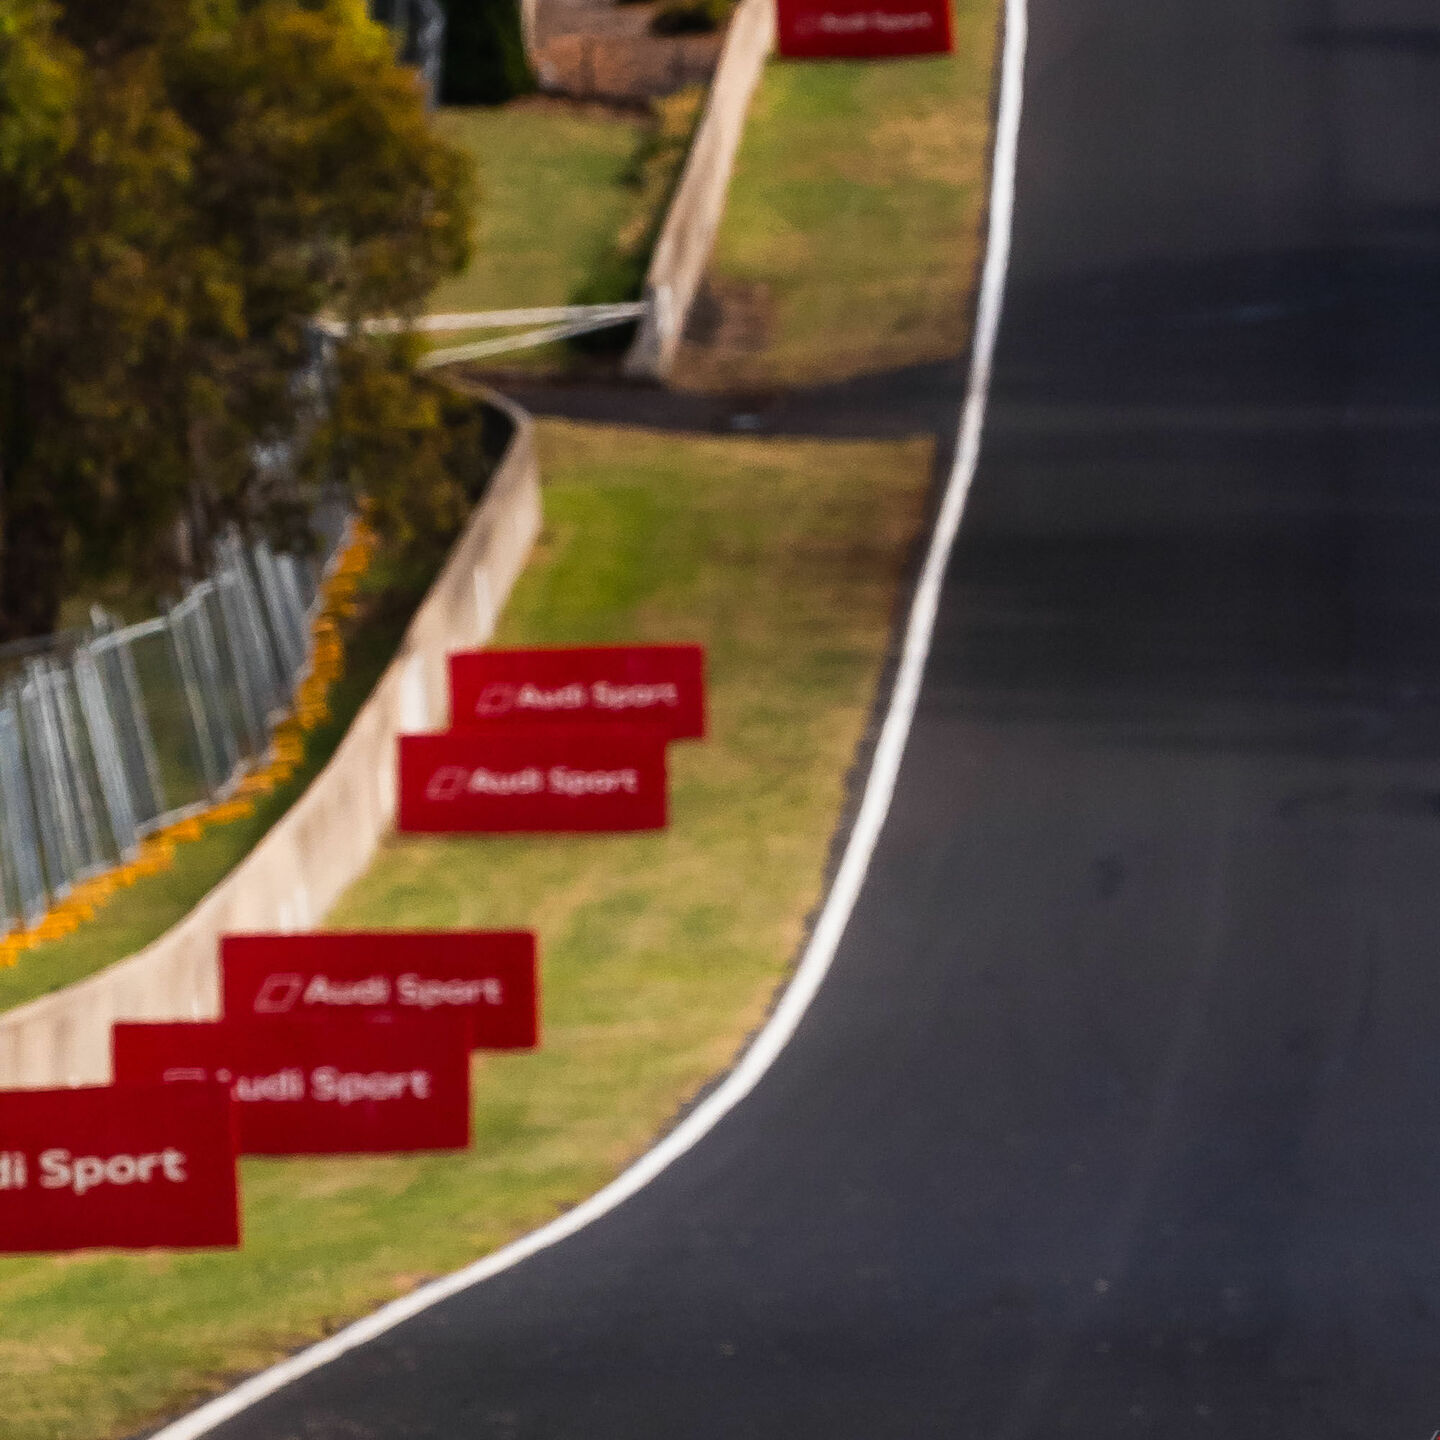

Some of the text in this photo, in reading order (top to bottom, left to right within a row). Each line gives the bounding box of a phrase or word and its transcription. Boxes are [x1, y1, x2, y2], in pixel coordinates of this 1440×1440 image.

[519, 680, 679, 710] Audi Sport
[469, 766, 638, 798] Audi Sport
[304, 972, 502, 1010] Audi Sport
[234, 1066, 430, 1106] udi Sport
[38, 1148, 186, 1195] Sport
